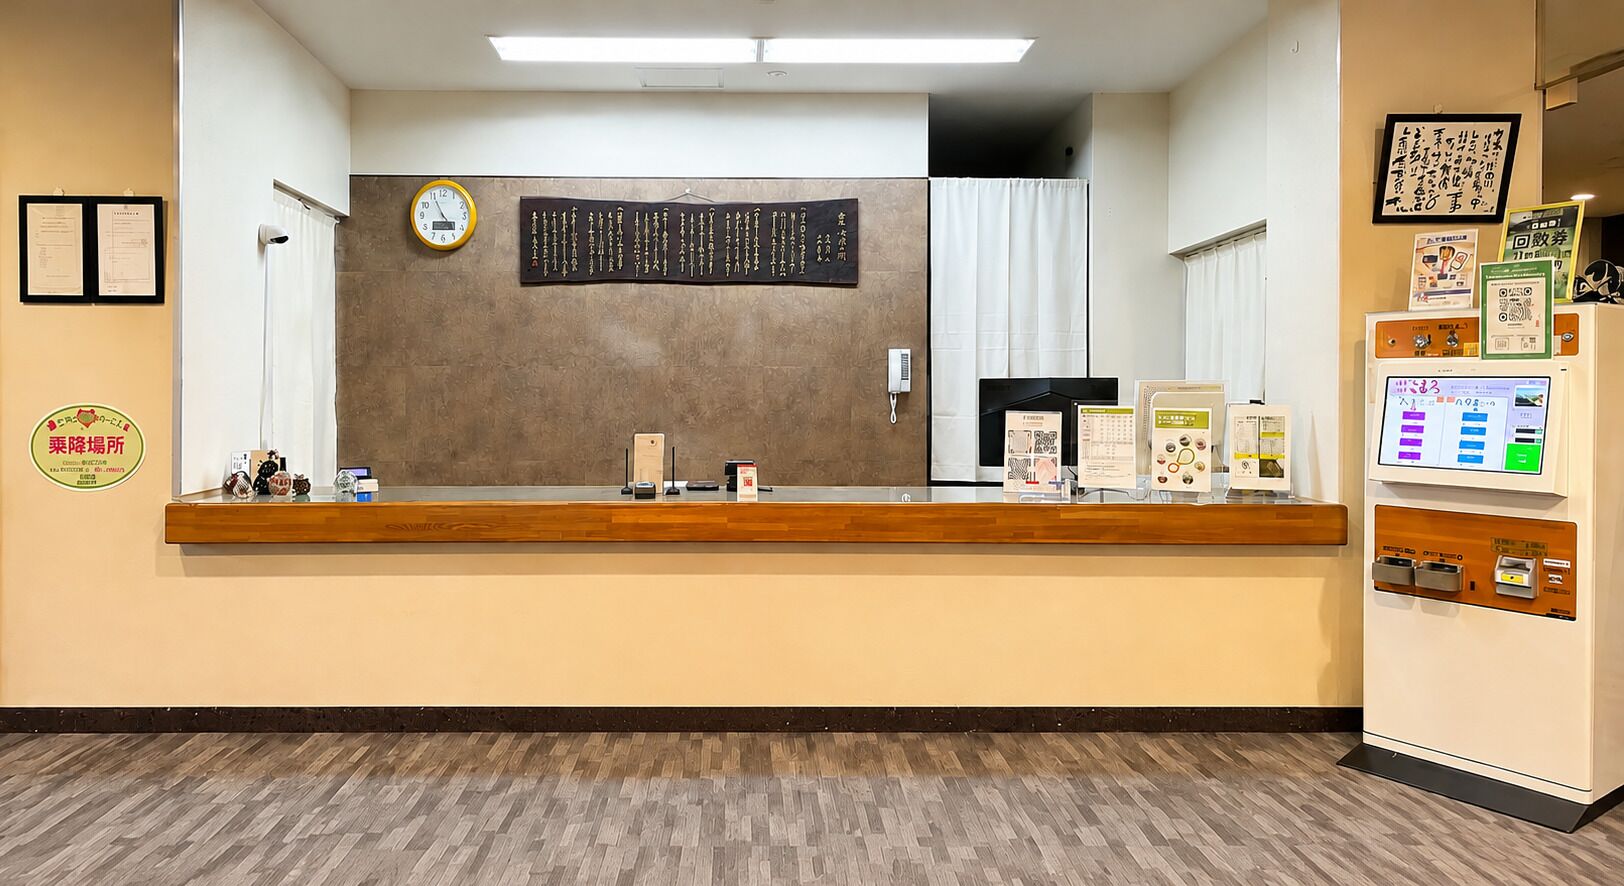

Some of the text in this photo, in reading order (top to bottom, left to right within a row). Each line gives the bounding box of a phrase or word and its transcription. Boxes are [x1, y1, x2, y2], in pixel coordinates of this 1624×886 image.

[430, 192, 436, 200] 11
[439, 189, 448, 197] 12
[421, 201, 430, 209] 10
[459, 201, 465, 209] 2
[419, 211, 425, 219] 9
[431, 232, 436, 240] 7
[440, 234, 446, 243] 6
[1513, 229, 1568, 249] 回数券
[49, 436, 125, 455] 乗降場所
